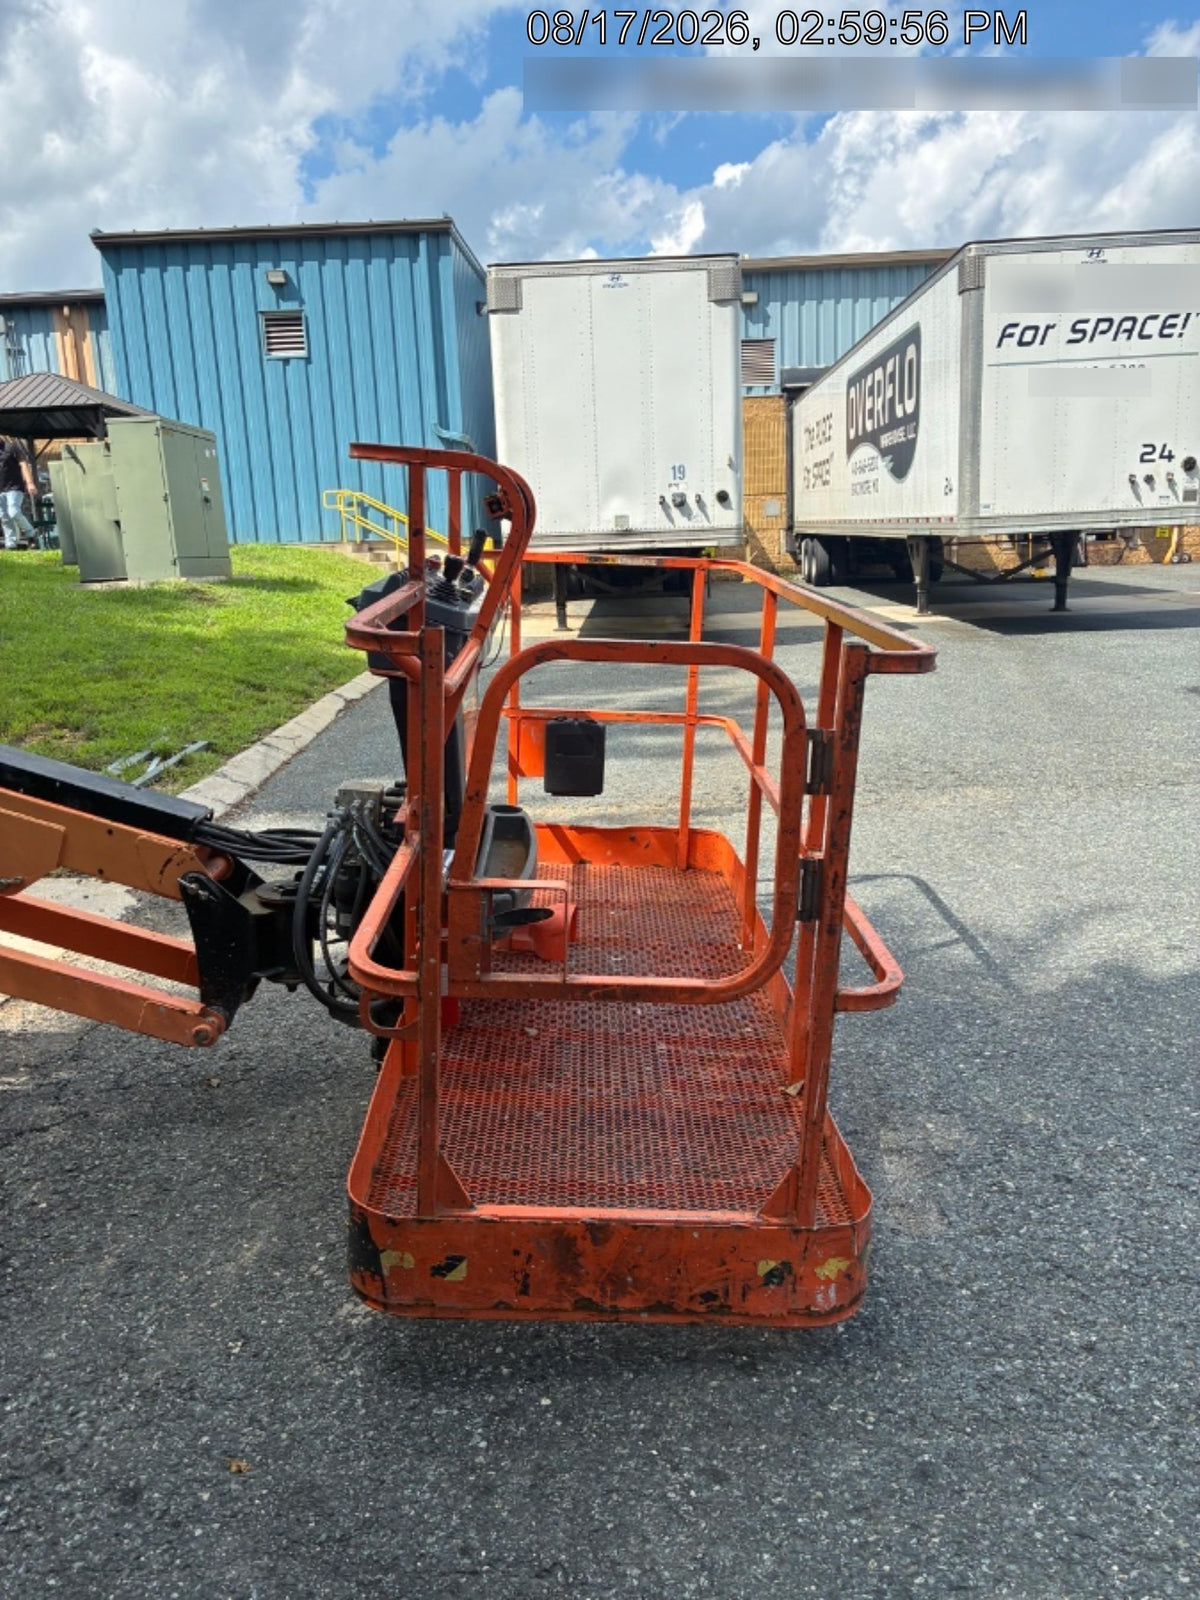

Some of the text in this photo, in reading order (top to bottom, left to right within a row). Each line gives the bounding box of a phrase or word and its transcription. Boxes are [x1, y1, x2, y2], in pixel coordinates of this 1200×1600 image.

[996, 323, 1057, 349] For
[849, 343, 917, 440] OVERFLO
[1138, 443, 1175, 463] 24
[671, 464, 686, 481] 19
